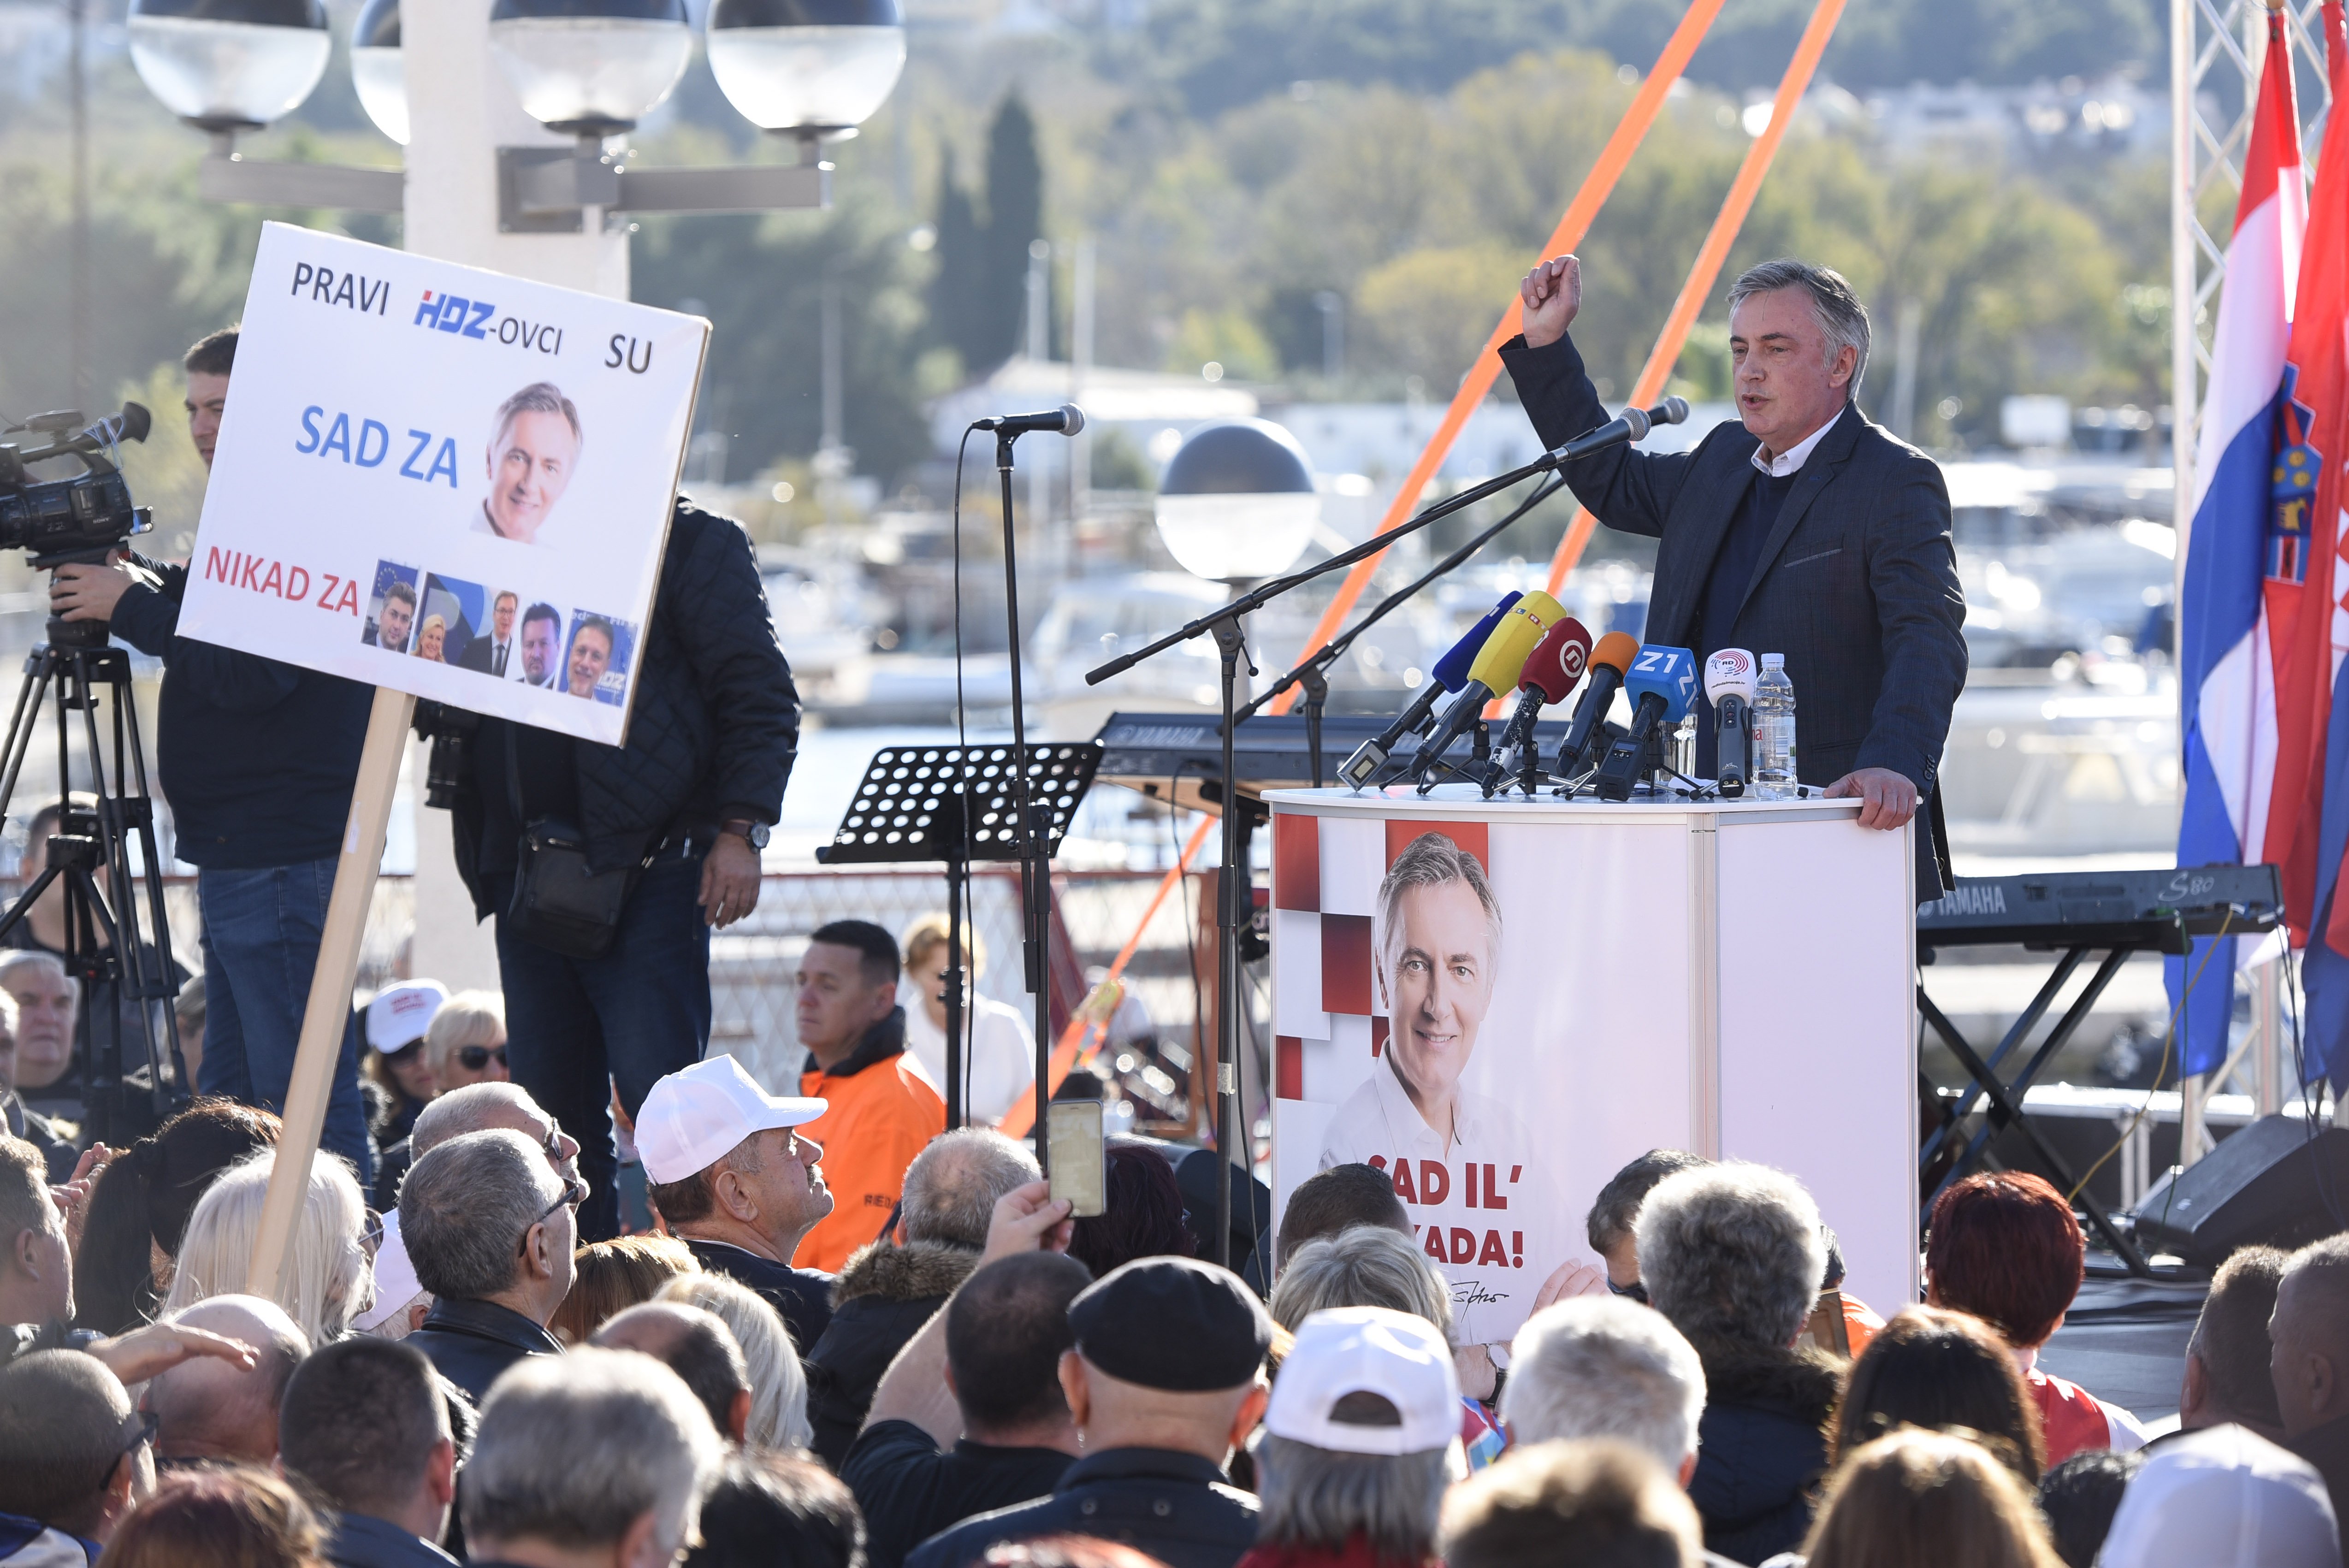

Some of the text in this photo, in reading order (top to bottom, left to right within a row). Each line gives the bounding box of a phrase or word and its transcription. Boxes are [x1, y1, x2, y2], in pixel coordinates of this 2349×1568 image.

[290, 261, 652, 374] PRAVI HDZ-OVCI SU
[295, 405, 457, 488] SAD ZA
[204, 546, 358, 617] NIKAD ZA
[1634, 651, 1679, 673] Z1
[1679, 663, 1698, 709] Z1
[2158, 870, 2214, 901] S80
[1414, 1225, 1524, 1269] ADA!
